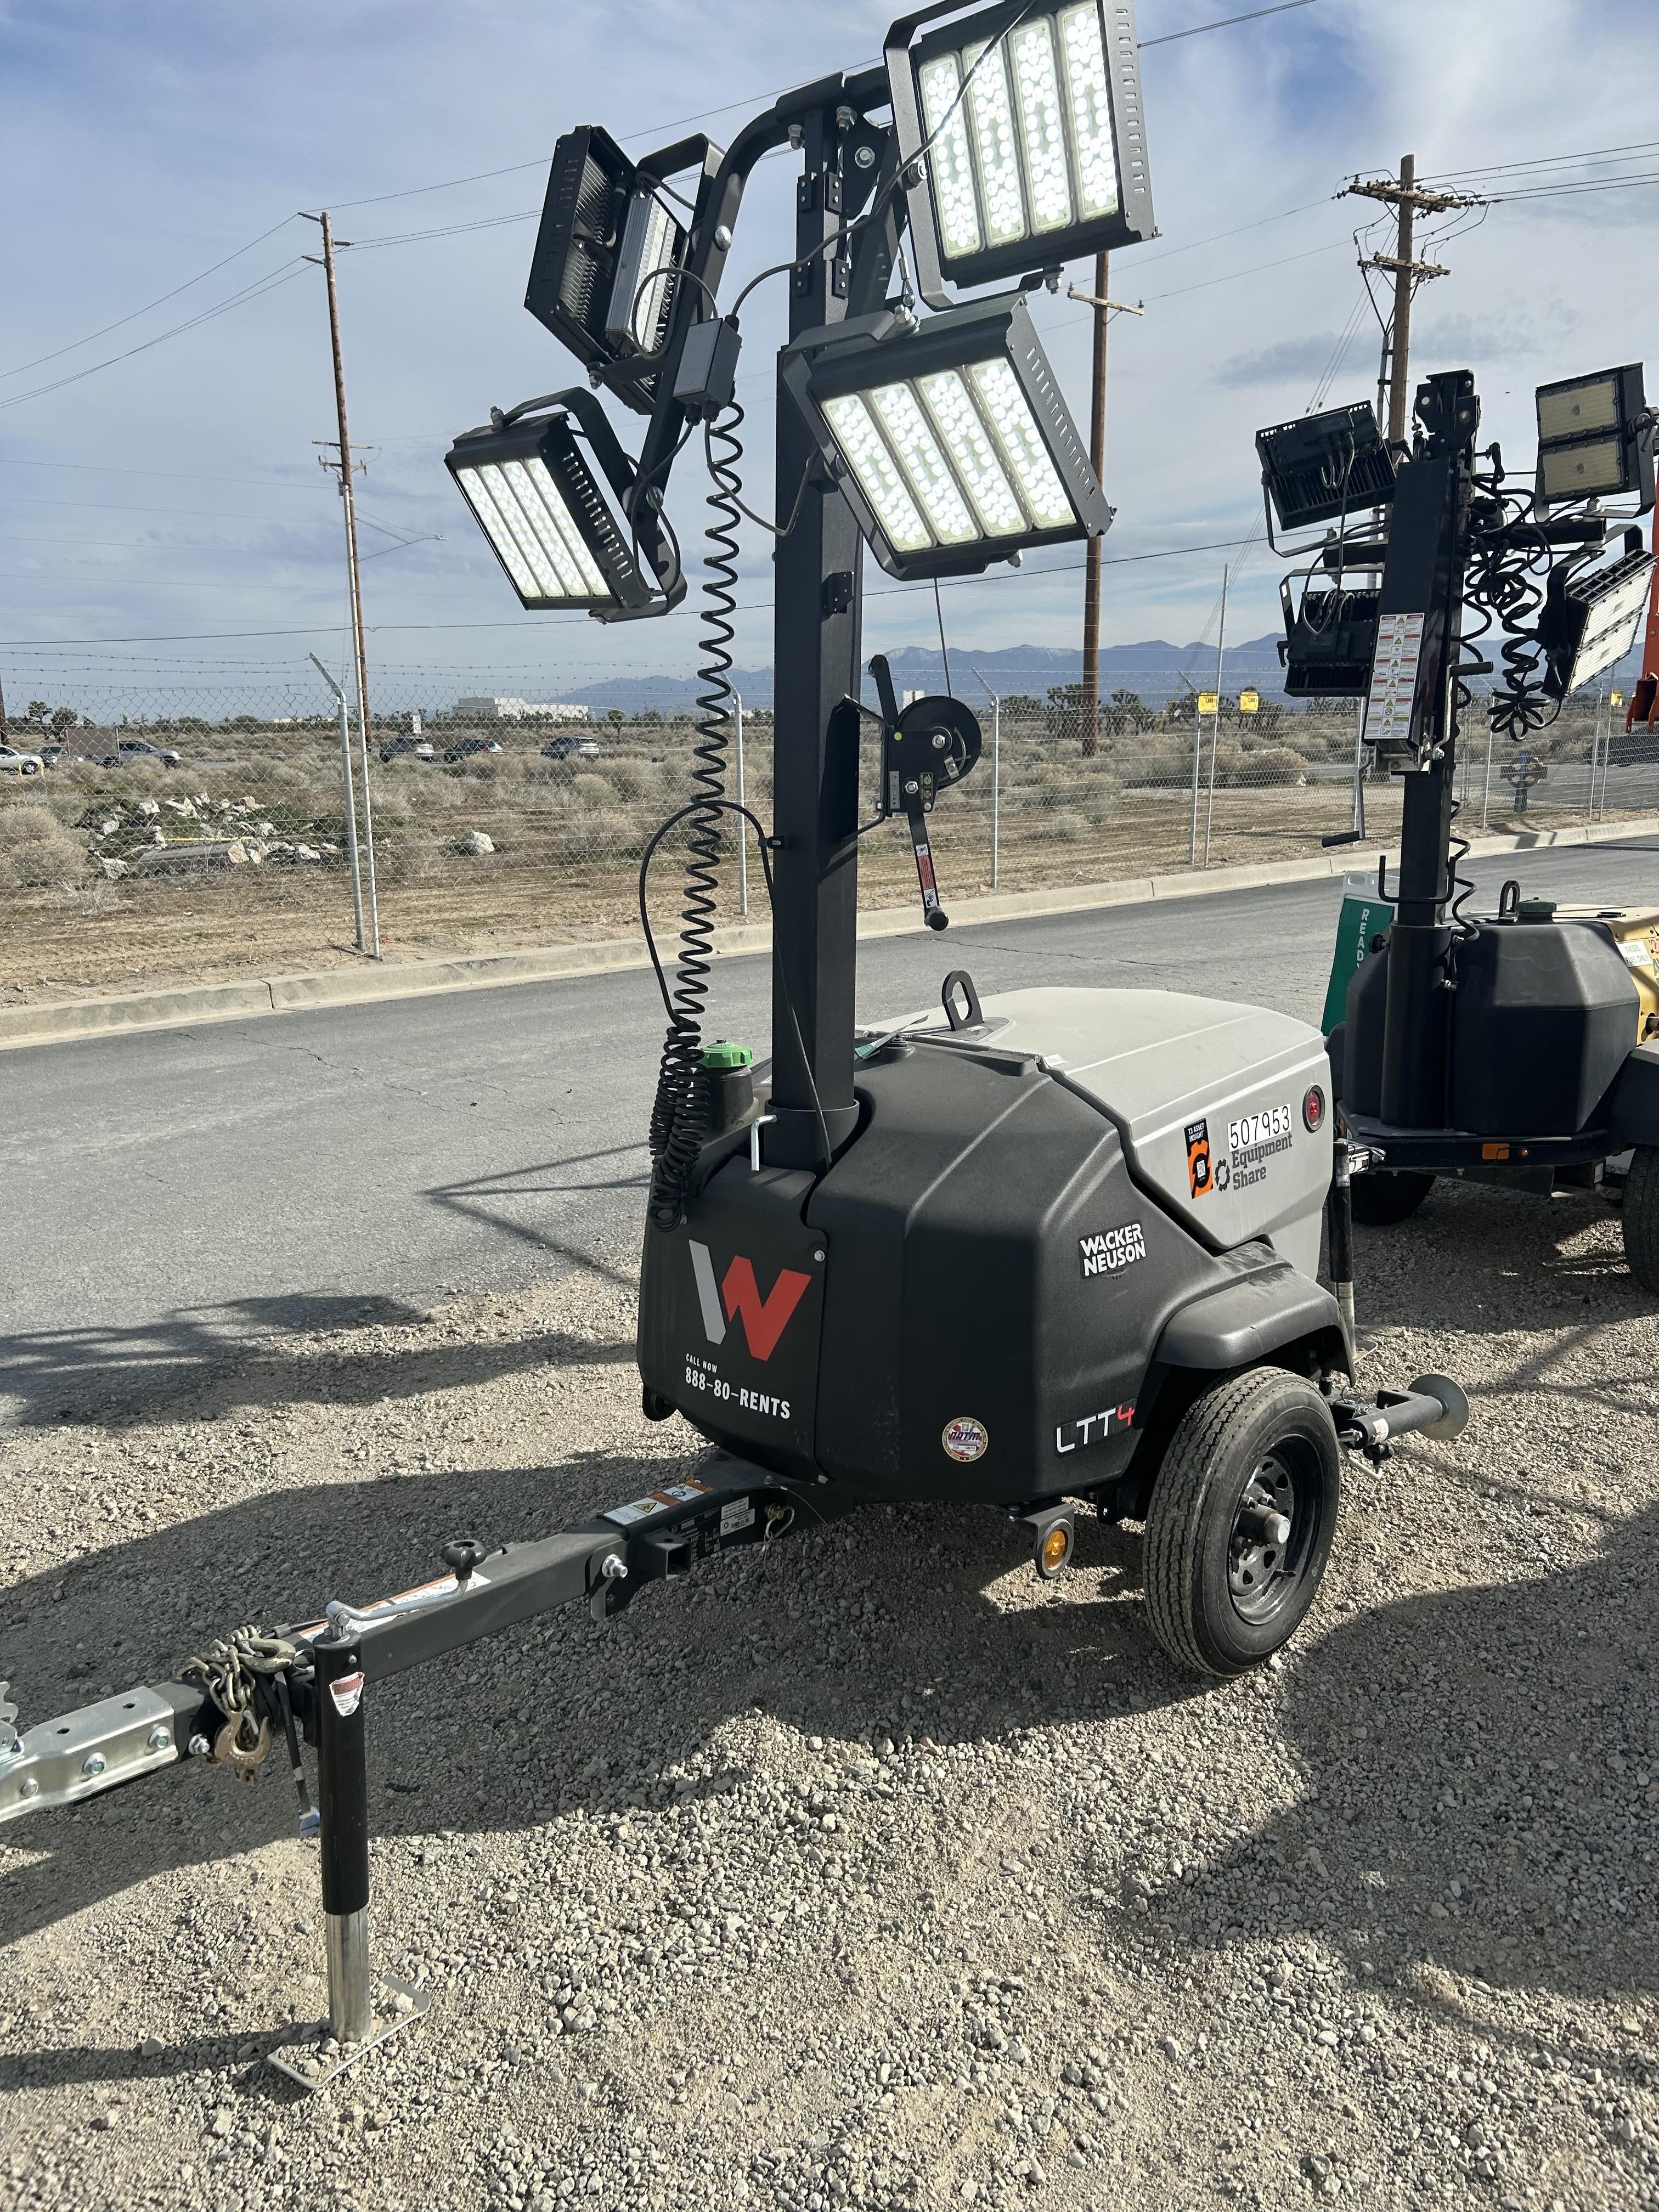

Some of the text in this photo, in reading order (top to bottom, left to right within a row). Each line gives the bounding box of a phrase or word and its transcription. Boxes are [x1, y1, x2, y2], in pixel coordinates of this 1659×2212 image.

[1231, 1105, 1289, 1149] 507953
[1231, 1132, 1293, 1169] Equipment
[1233, 1166, 1266, 1190] Share
[1080, 1223, 1143, 1256] WACKER
[1084, 1240, 1146, 1277] NEUSON
[686, 1353, 718, 1373] CALL NOW
[686, 1367, 790, 1419] 888-80-RENTS
[1057, 1404, 1135, 1453] LTT4
